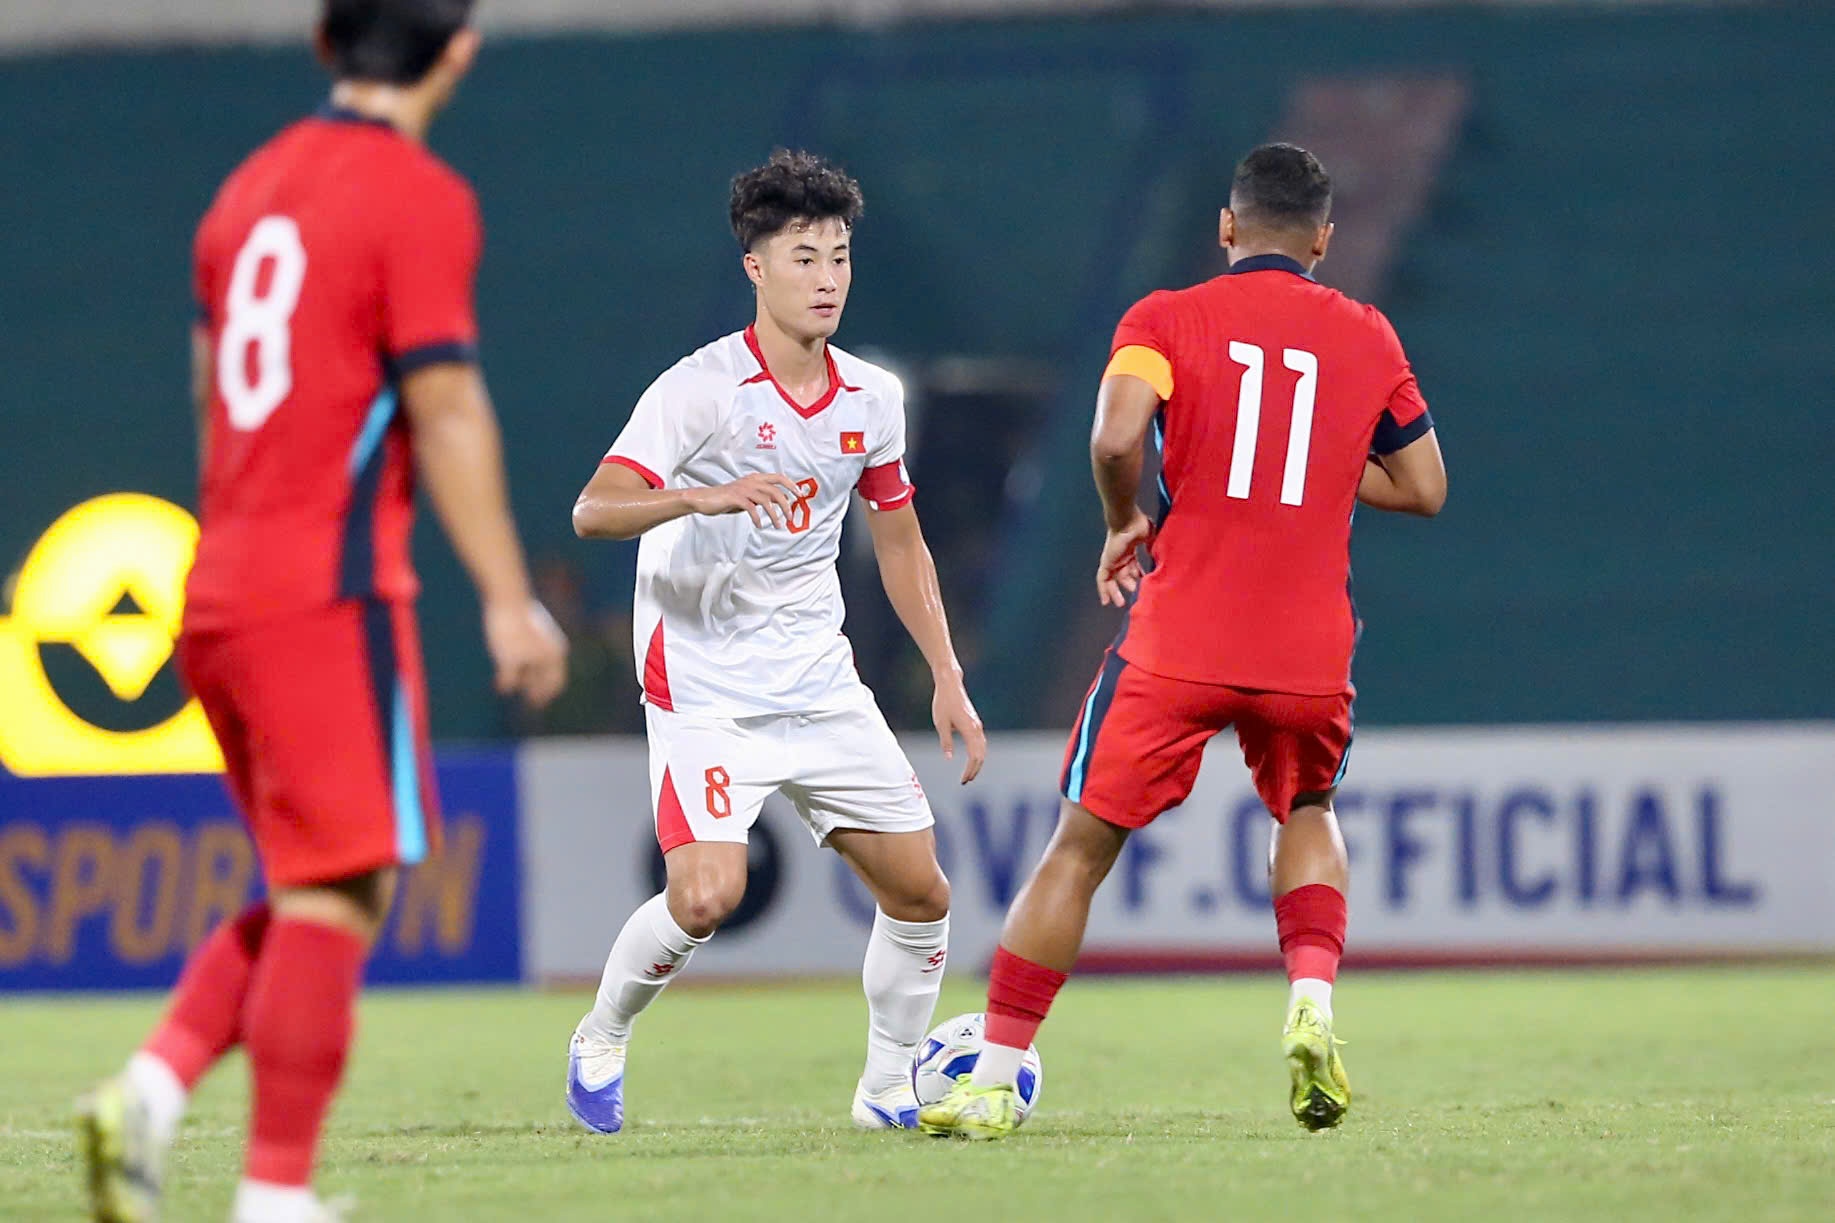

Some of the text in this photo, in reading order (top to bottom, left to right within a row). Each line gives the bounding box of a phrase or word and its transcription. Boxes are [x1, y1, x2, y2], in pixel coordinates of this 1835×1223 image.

[219, 215, 308, 431] 8
[1226, 340, 1318, 506] 11
[785, 477, 818, 534] 8
[704, 765, 732, 820] 8
